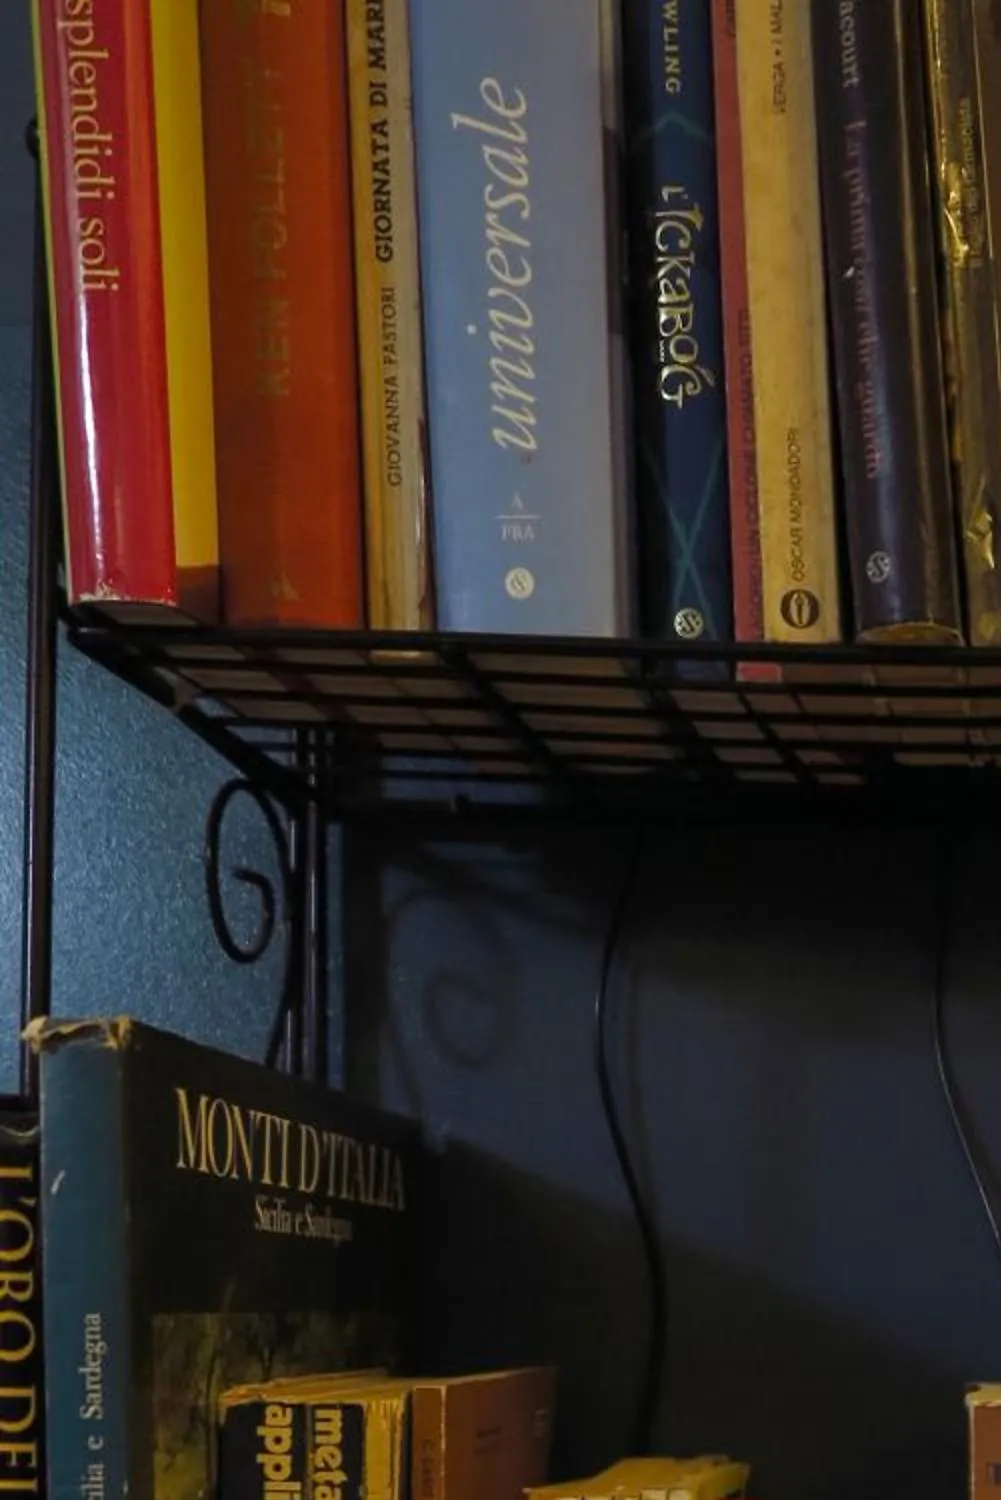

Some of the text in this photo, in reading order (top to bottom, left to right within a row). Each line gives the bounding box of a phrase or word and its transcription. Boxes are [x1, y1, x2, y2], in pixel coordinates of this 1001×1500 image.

[369, 81, 387, 108] DI
[662, 0, 683, 95] WLING
[56, 0, 120, 293] splendidi soli
[370, 119, 393, 263] GIORNATA
[450, 76, 539, 450] universale
[380, 286, 398, 364] PASTORI
[383, 375, 402, 487] GIOVANNA
[787, 427, 806, 582] OSCAR MONDADORI
[174, 1086, 407, 1213] MONTI D'ITALIA
[77, 1312, 108, 1421] Sardegna
[0, 1383, 40, 1494] DEI
[86, 1434, 104, 1452] e
